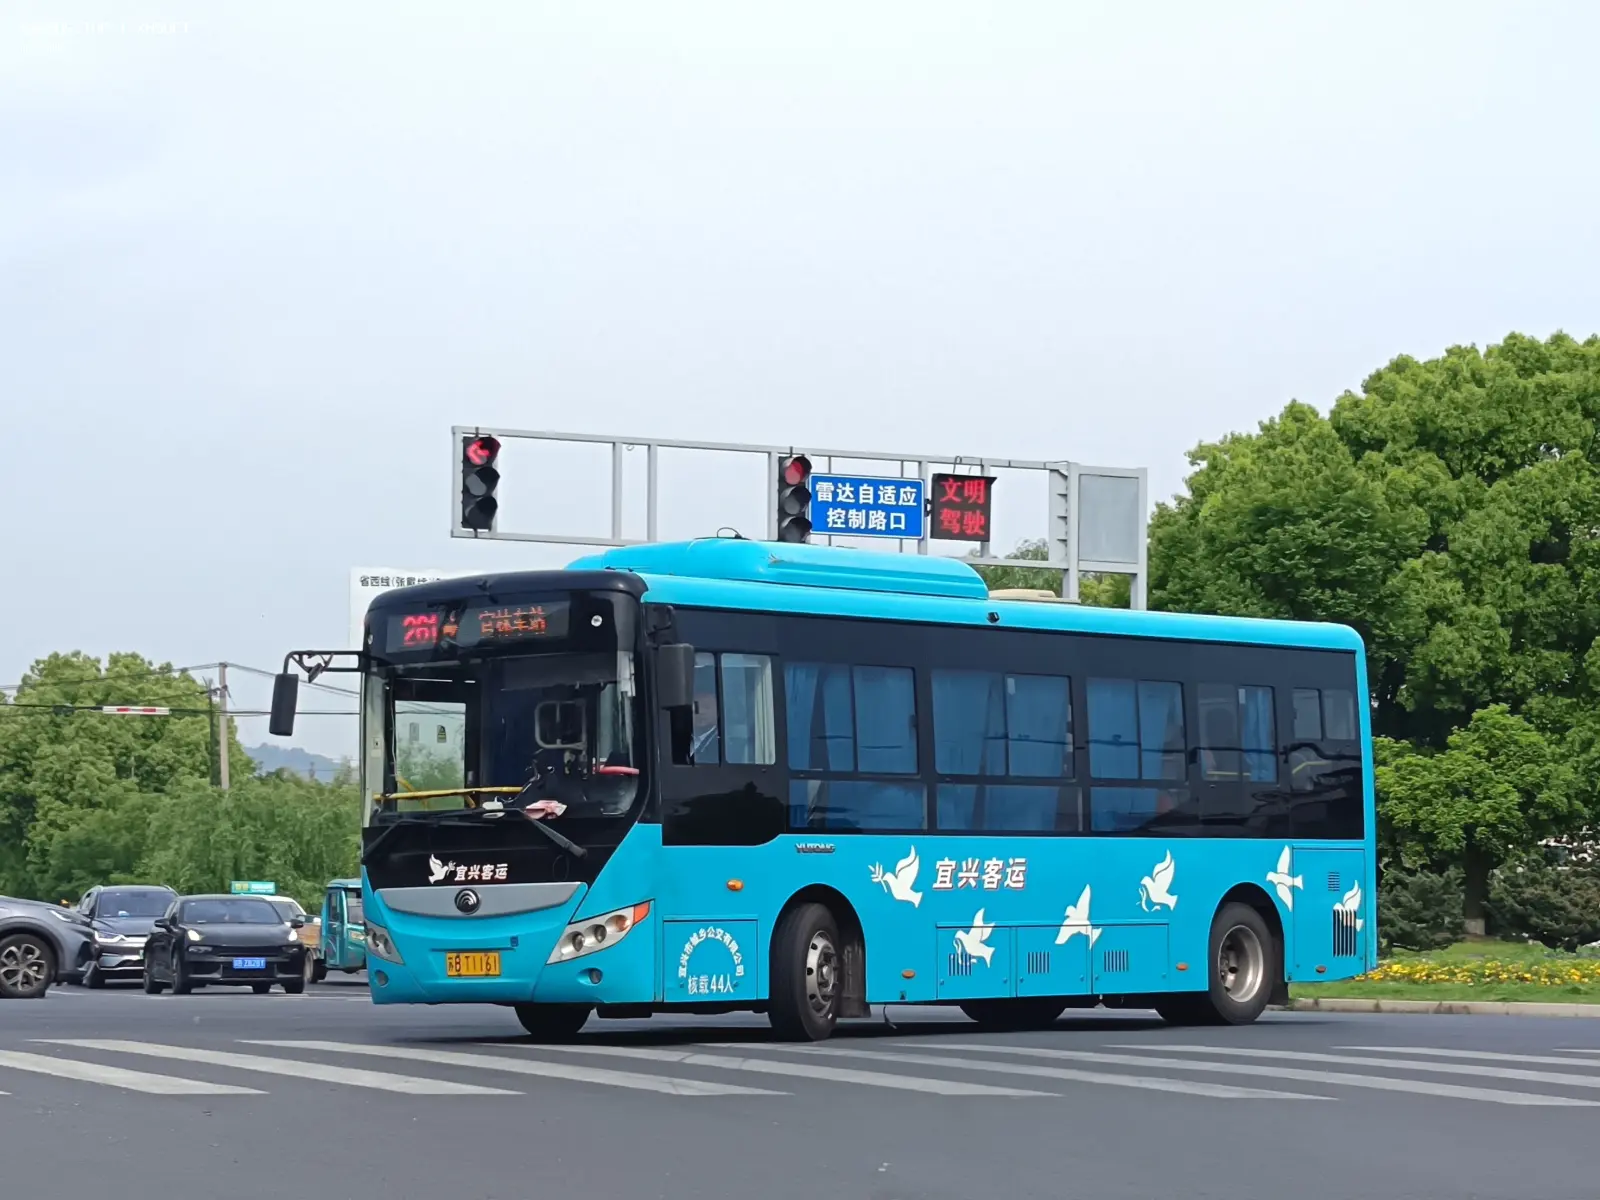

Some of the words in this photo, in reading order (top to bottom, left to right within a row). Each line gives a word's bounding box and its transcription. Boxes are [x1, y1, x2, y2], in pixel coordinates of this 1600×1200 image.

[815, 481, 918, 507] 雷达自适应
[939, 478, 986, 504] 文明
[826, 507, 907, 531] 控制路口
[939, 508, 986, 536] 驾驶
[454, 863, 508, 881] 宜兴客运
[932, 857, 1028, 889] 宜兴客运
[688, 973, 734, 995] 核载44人
